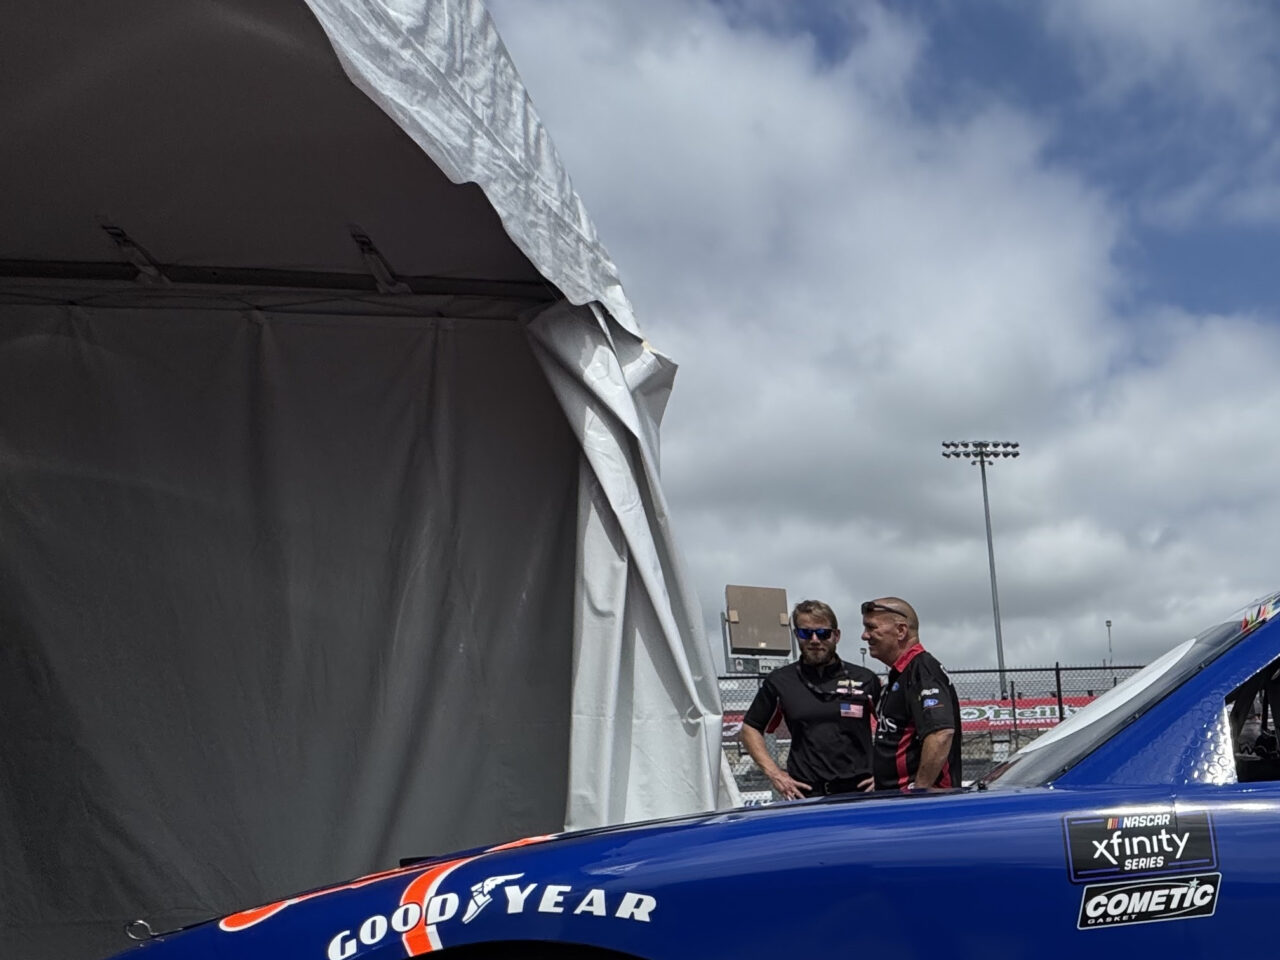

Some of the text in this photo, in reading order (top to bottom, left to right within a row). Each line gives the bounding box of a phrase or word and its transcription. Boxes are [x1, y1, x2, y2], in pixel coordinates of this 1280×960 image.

[961, 706, 1077, 719] O'Reily
[1123, 814, 1170, 829] NASCAR
[1092, 829, 1190, 865] xfinity
[1124, 856, 1164, 870] SERIES
[1086, 884, 1214, 918] COMETIC
[1088, 914, 1137, 924] GASKET
